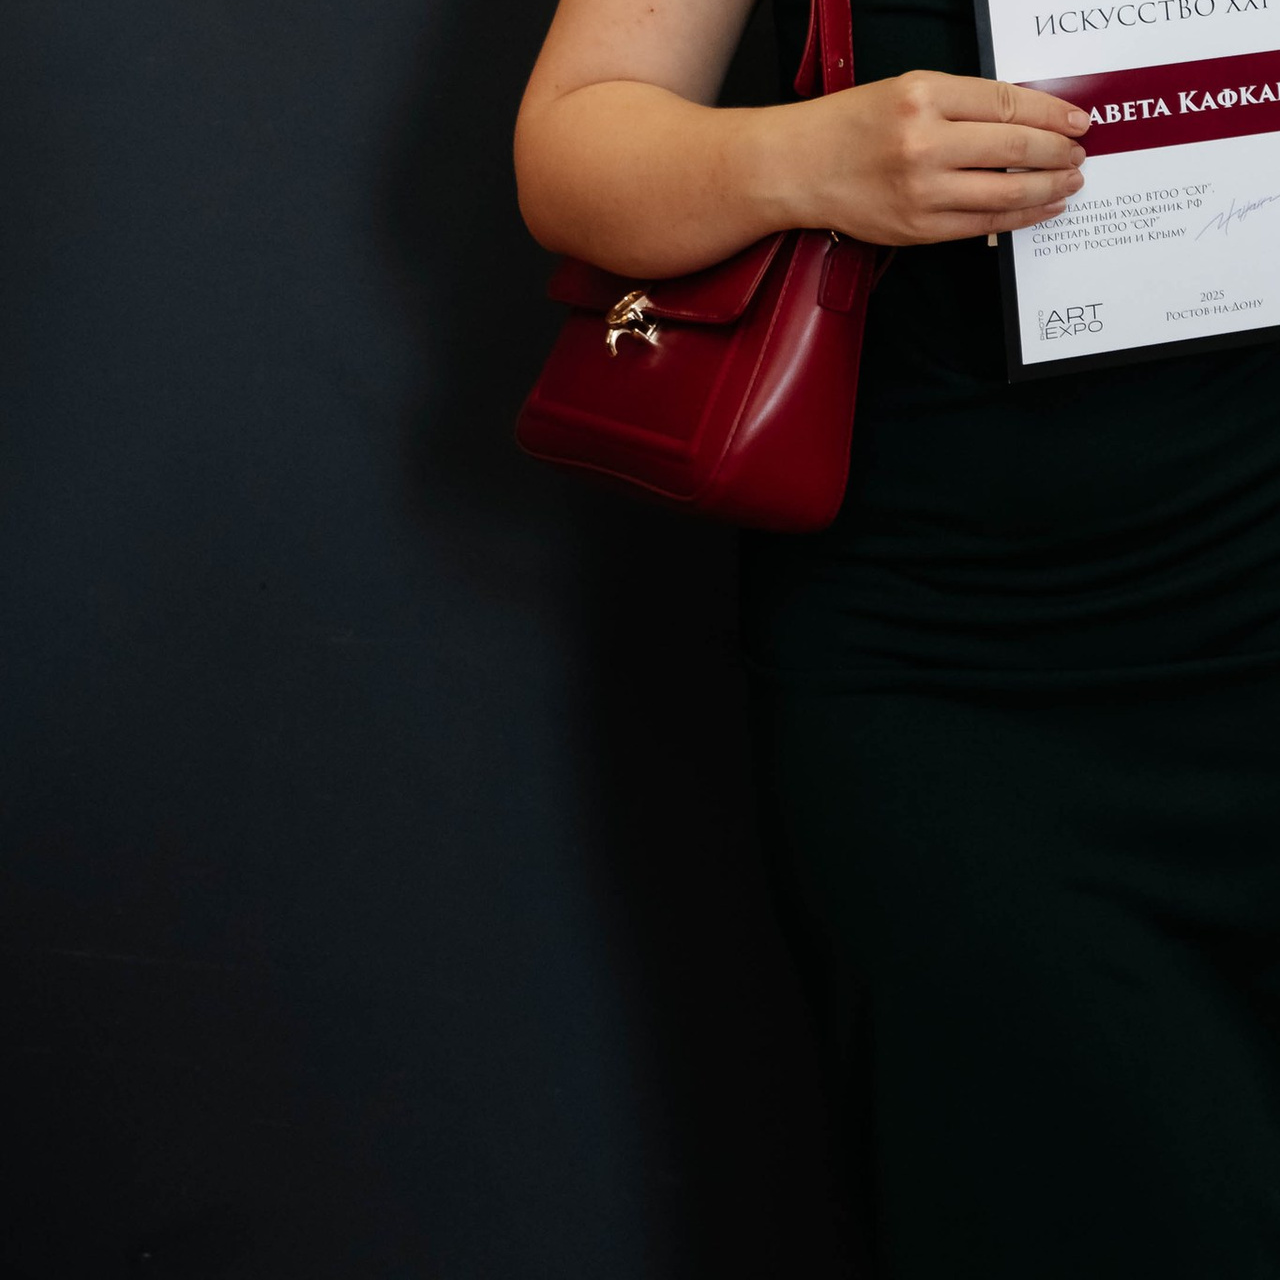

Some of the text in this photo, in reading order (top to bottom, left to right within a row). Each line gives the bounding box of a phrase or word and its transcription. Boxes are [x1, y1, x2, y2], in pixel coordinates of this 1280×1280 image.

[1088, 97, 1172, 126] АВЕТА
[1067, 198, 1112, 213] ЕДАТЕЛЬ
[1116, 193, 1142, 206] РОО
[1146, 188, 1179, 202] ВТОО
[1120, 200, 1183, 219] ХУДОЖНИК
[1187, 198, 1202, 209] РФ
[1032, 228, 1090, 244] СЕКРЕТАРЬ
[1094, 221, 1127, 235] ВТОО
[1034, 227, 1187, 257] ПО ЮГУ РОССИИ И КРЫМУ
[1200, 289, 1225, 302] 2025
[1045, 303, 1103, 327] ART
[1165, 299, 1264, 322] РОСТОВ-НА-ДОНУ
[1045, 320, 1103, 340] EXPO
